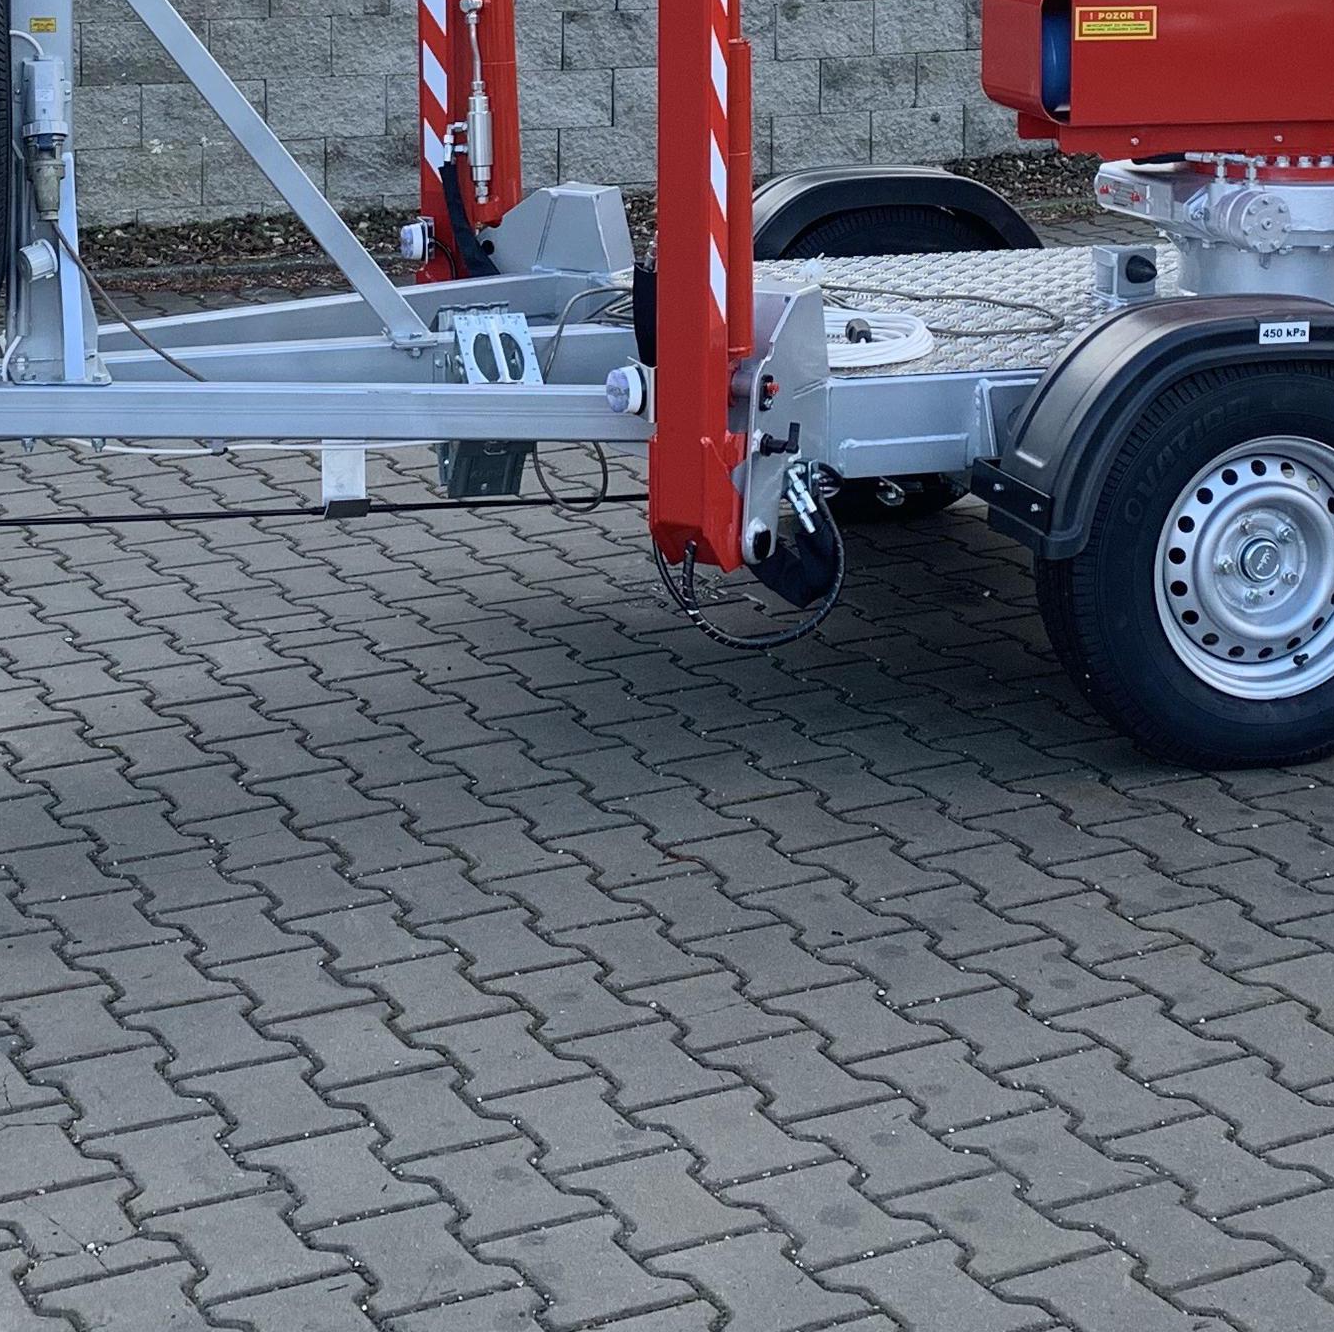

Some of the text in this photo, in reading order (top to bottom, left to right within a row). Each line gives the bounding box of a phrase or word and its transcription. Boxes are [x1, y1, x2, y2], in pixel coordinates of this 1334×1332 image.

[1098, 11, 1135, 20] POZOR
[1263, 327, 1307, 338] 450 kPa
